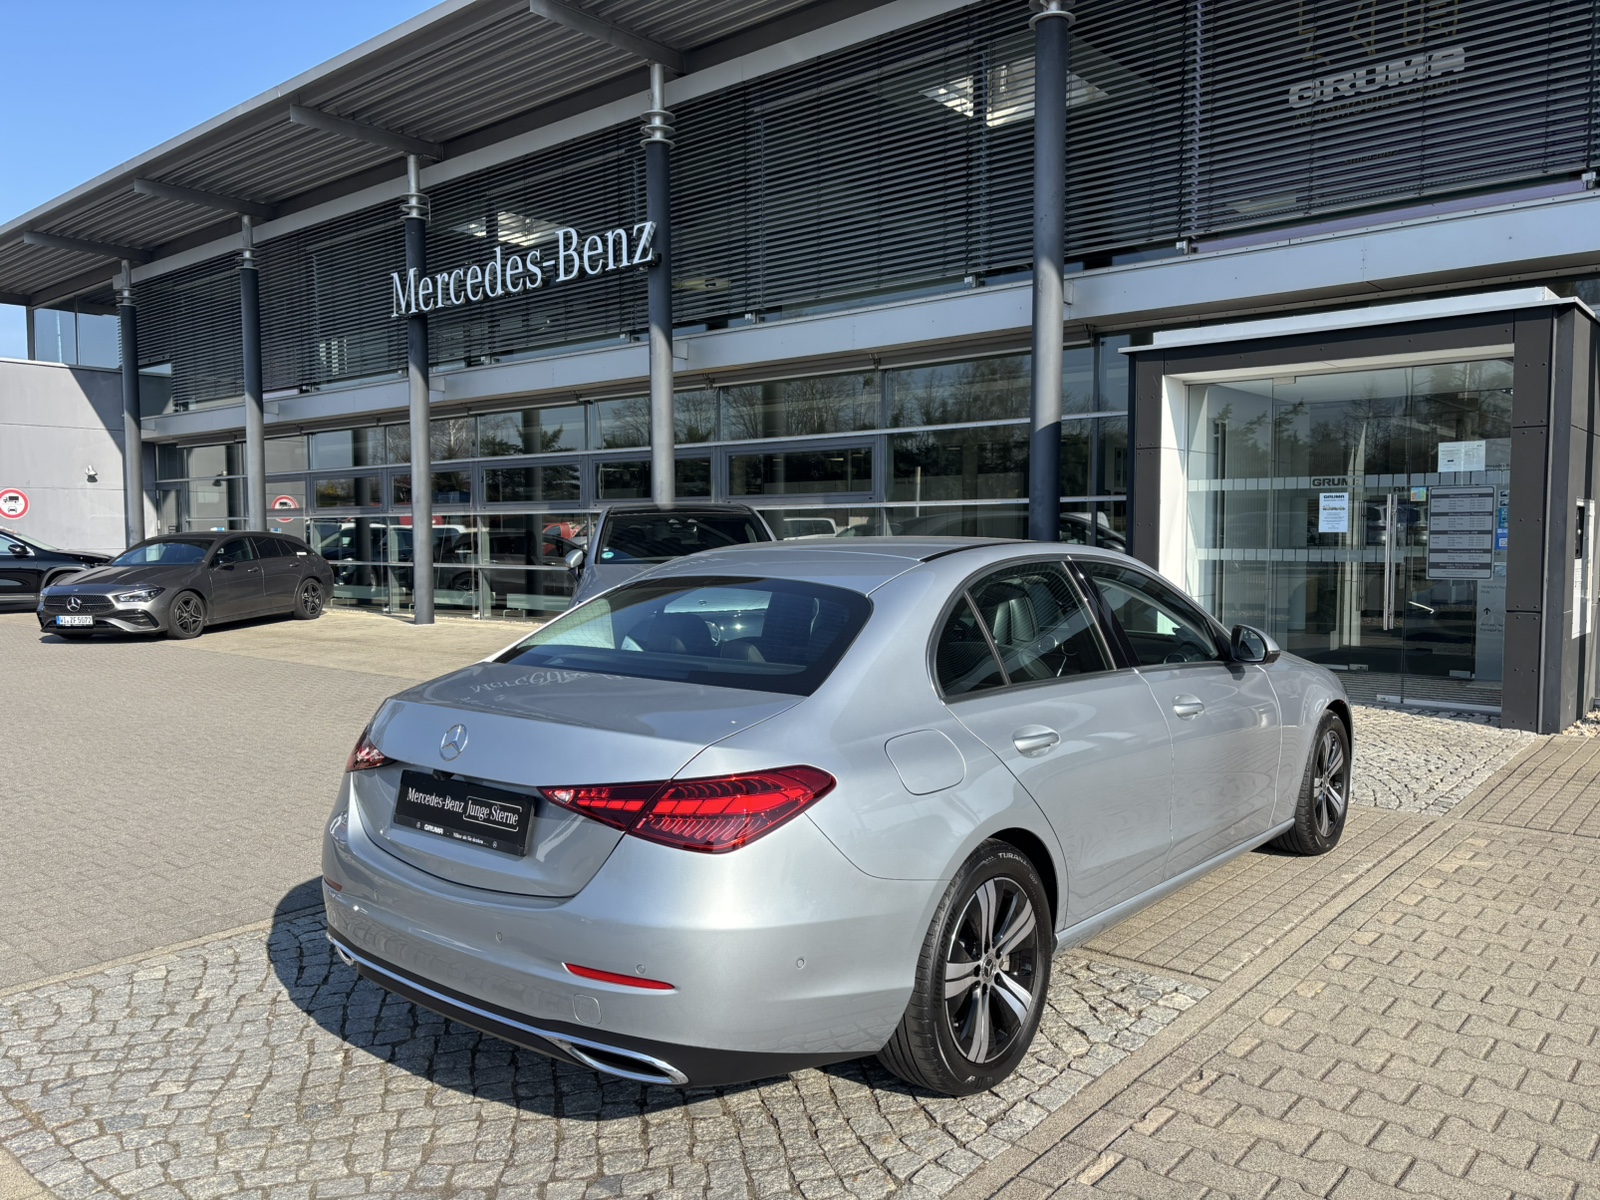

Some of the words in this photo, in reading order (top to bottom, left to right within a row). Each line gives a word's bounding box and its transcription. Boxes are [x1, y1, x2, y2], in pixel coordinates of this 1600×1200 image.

[1289, 48, 1465, 108] GRUMA
[391, 221, 658, 319] Mercedes-Benz
[407, 787, 465, 813] Mercedes-Benz
[466, 800, 490, 821] Junge
[490, 804, 519, 825] Sterne
